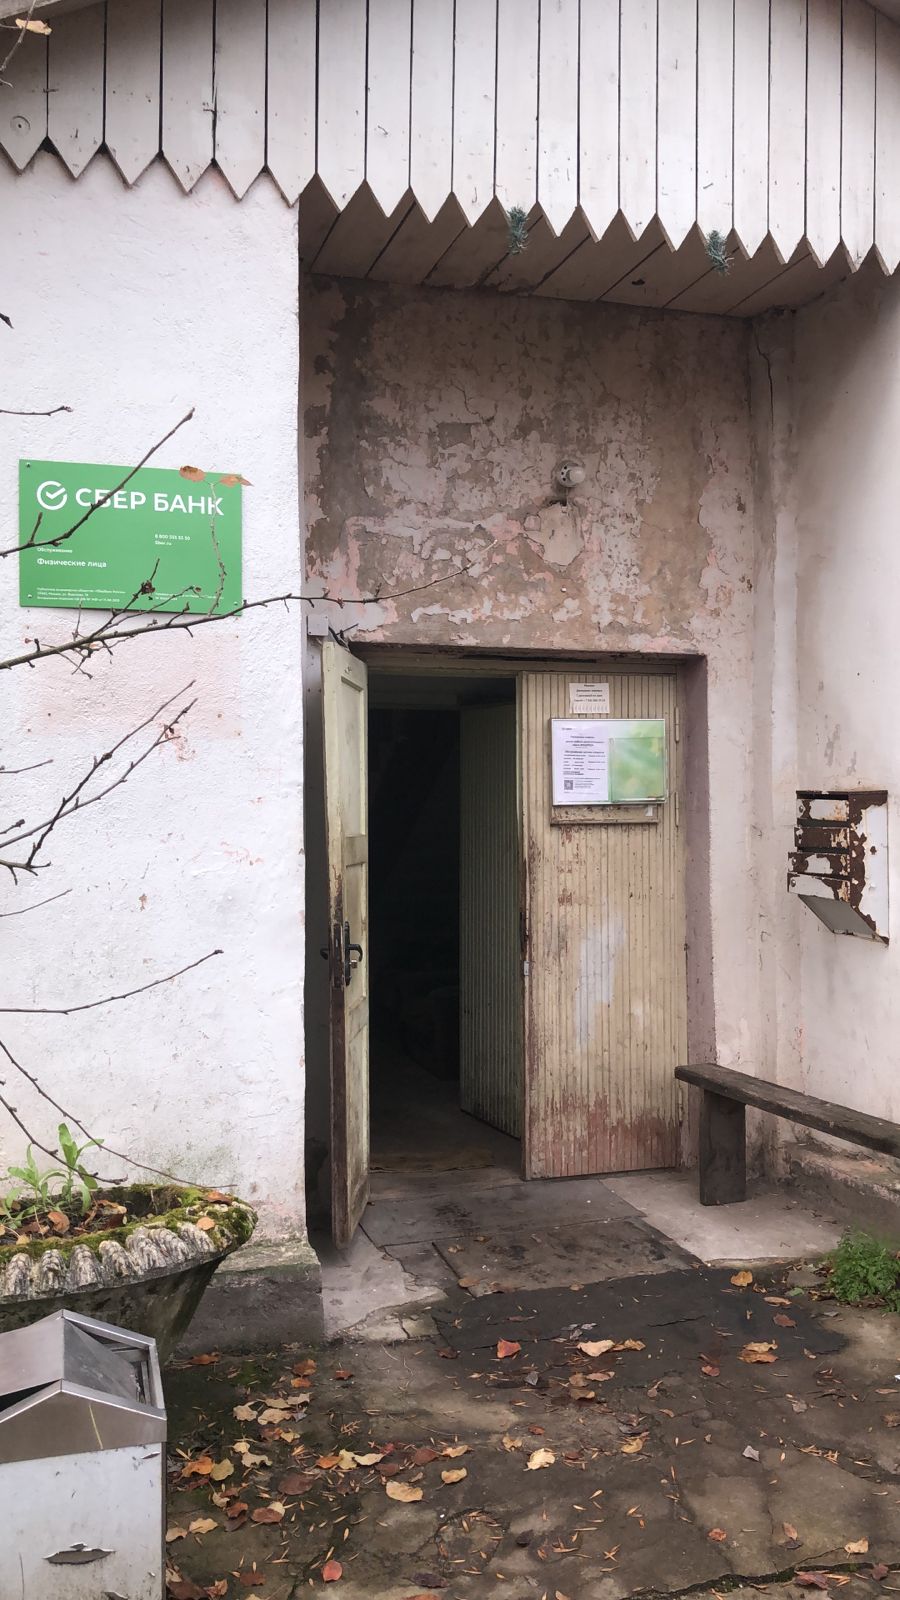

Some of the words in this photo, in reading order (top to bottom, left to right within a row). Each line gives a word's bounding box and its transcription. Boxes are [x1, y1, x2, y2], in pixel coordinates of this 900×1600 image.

[75, 487, 147, 511] СБЕР
[153, 492, 225, 516] БАНК
[36, 557, 86, 567] Физические
[87, 560, 107, 569] лица
